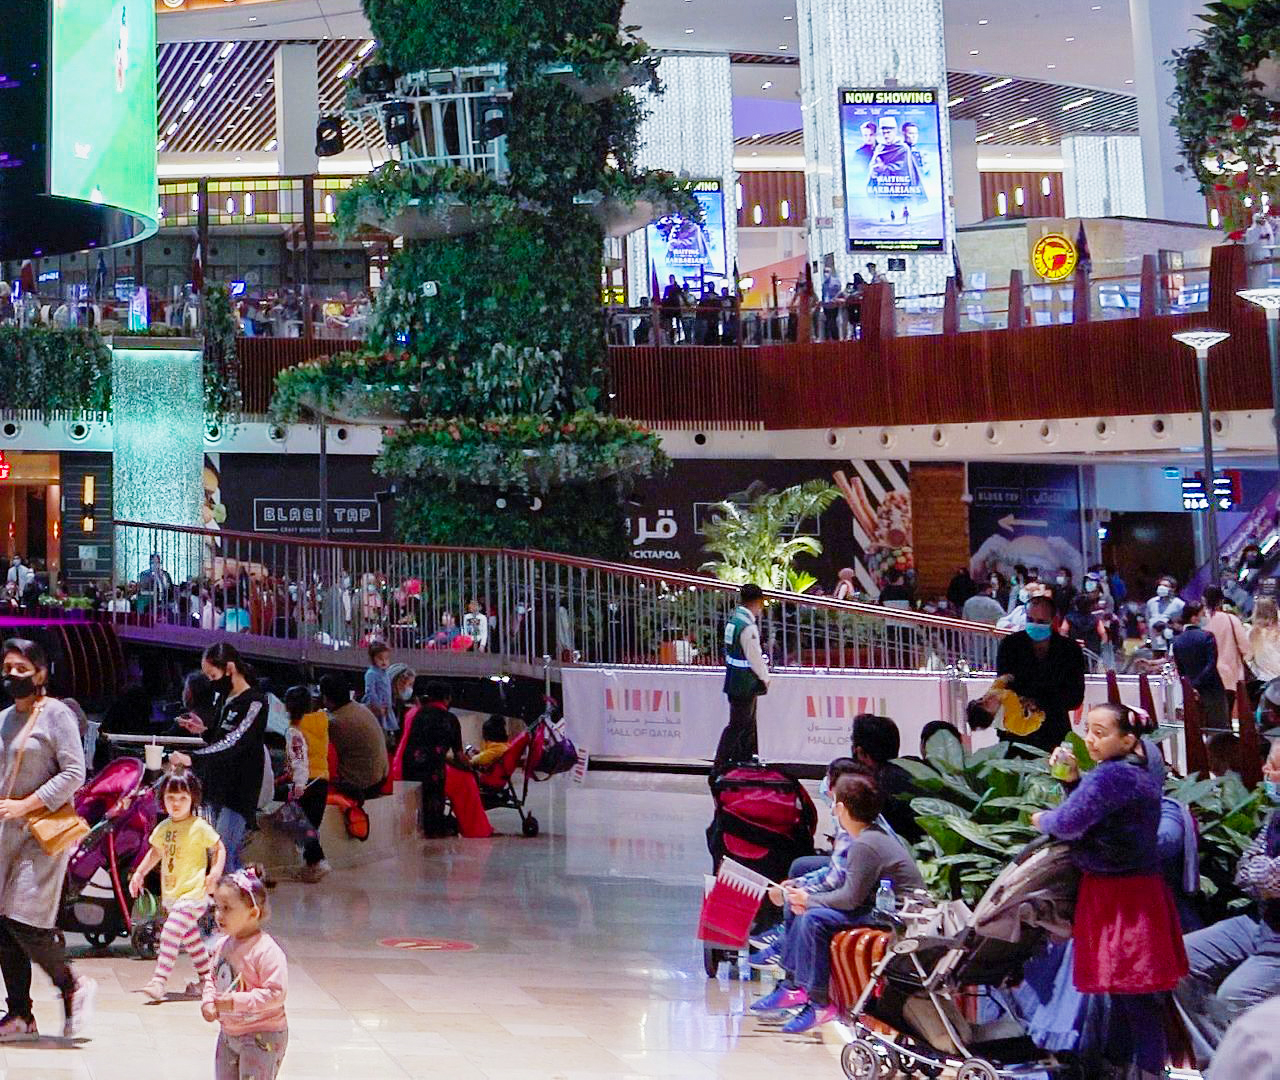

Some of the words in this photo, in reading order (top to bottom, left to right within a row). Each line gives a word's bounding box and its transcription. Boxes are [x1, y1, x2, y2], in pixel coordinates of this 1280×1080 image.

[845, 92, 873, 104] NOW
[875, 92, 933, 104] SHOWING
[263, 507, 322, 522] BLAC
[333, 508, 371, 522] TAP
[629, 550, 681, 560] CKTAPQA
[632, 728, 647, 737] OF
[648, 729, 681, 738] QATAR
[807, 736, 836, 745] MALL
